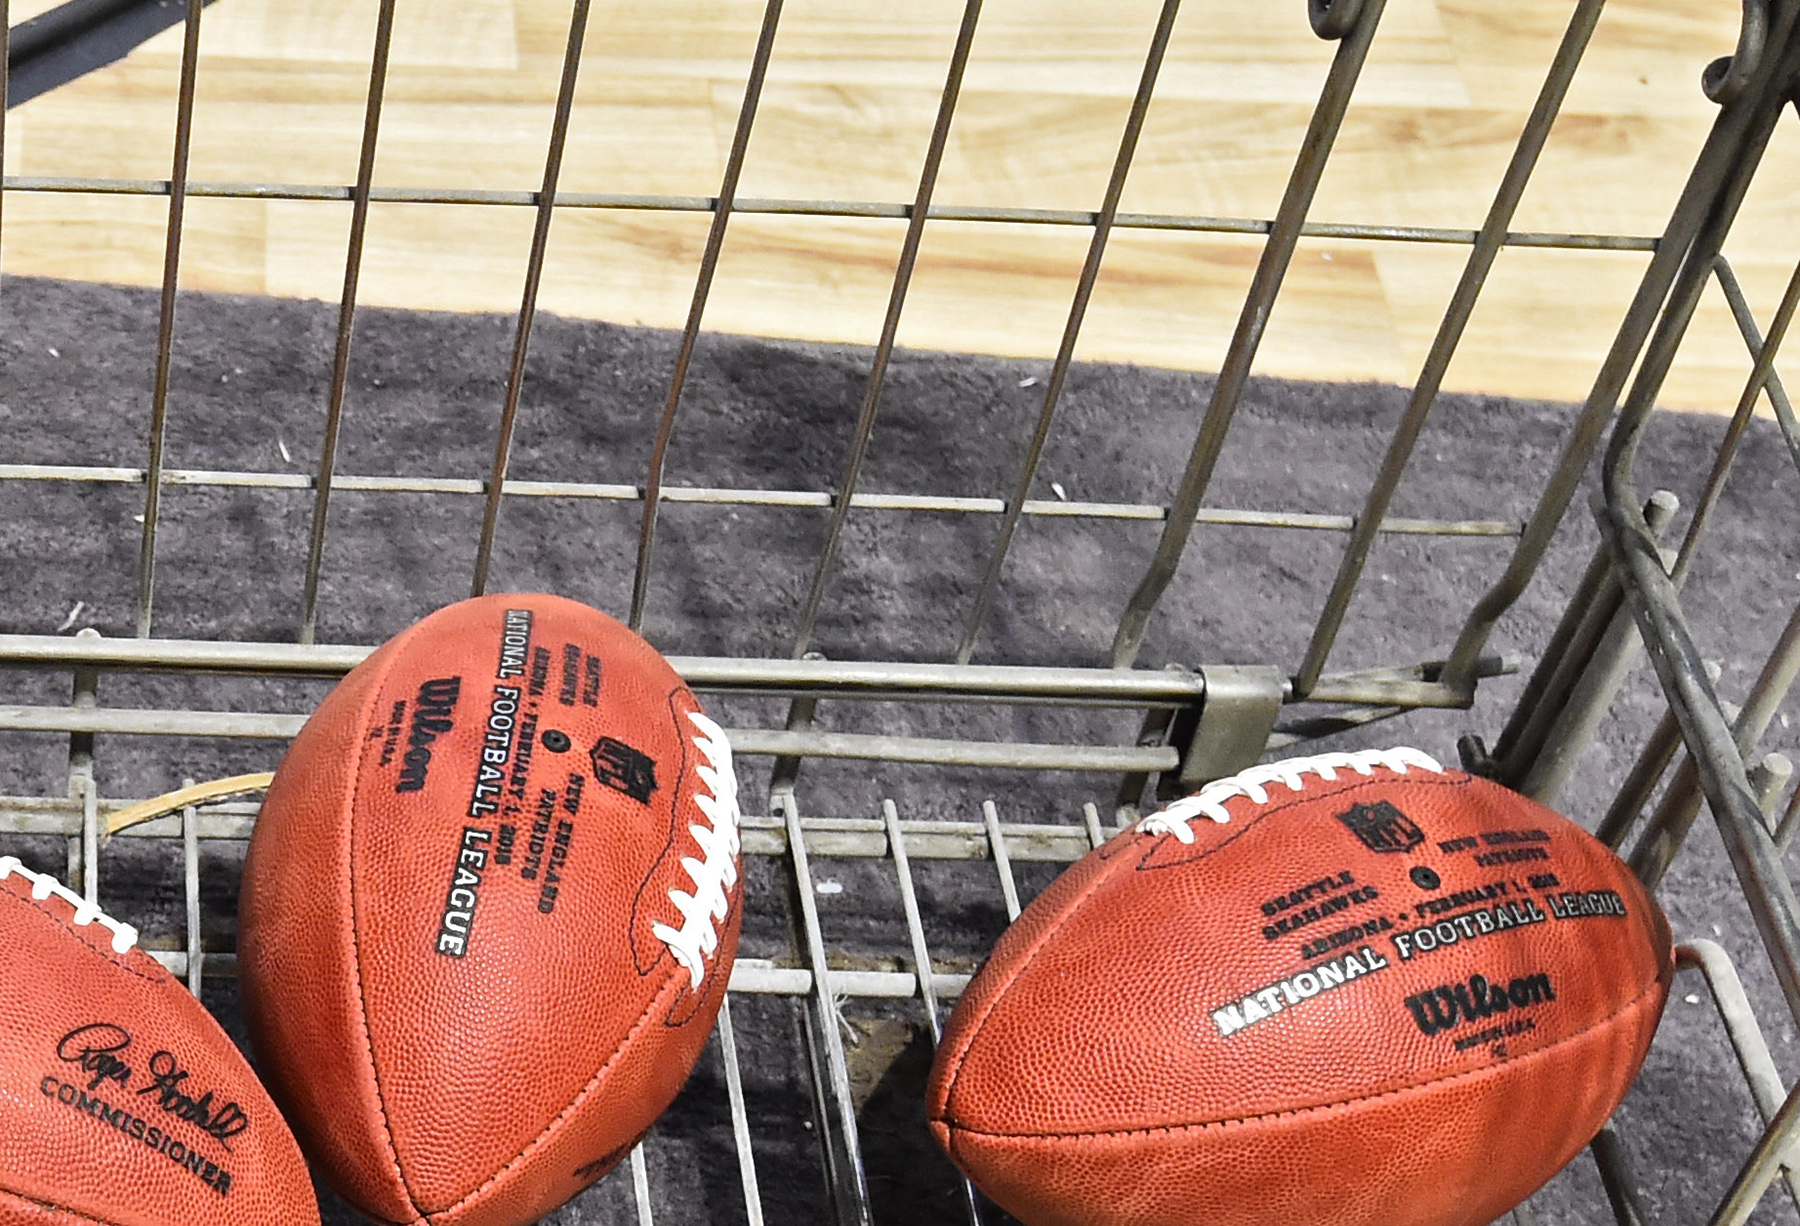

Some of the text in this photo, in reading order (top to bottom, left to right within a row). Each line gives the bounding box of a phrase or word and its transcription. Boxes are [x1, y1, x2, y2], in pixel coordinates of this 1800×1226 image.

[395, 676, 462, 794] Wilson
[509, 712, 539, 800] FEBRUARY
[435, 609, 532, 959] NATIONAL FOOTBALL LEAGUE
[521, 788, 557, 881] PATRIOTS
[537, 772, 585, 915] NEW ENGLAND
[1262, 870, 1355, 916] SEATTLE
[1262, 886, 1379, 939] SEAHAWKS
[1302, 917, 1394, 960] ARIZONA
[1414, 881, 1509, 919] FEBRUARY
[1210, 890, 1628, 1038] NATIONAL FOOTBALL LEAGUE
[1404, 972, 1557, 1037] Wilson
[40, 1076, 233, 1197] COMMISSIONER
